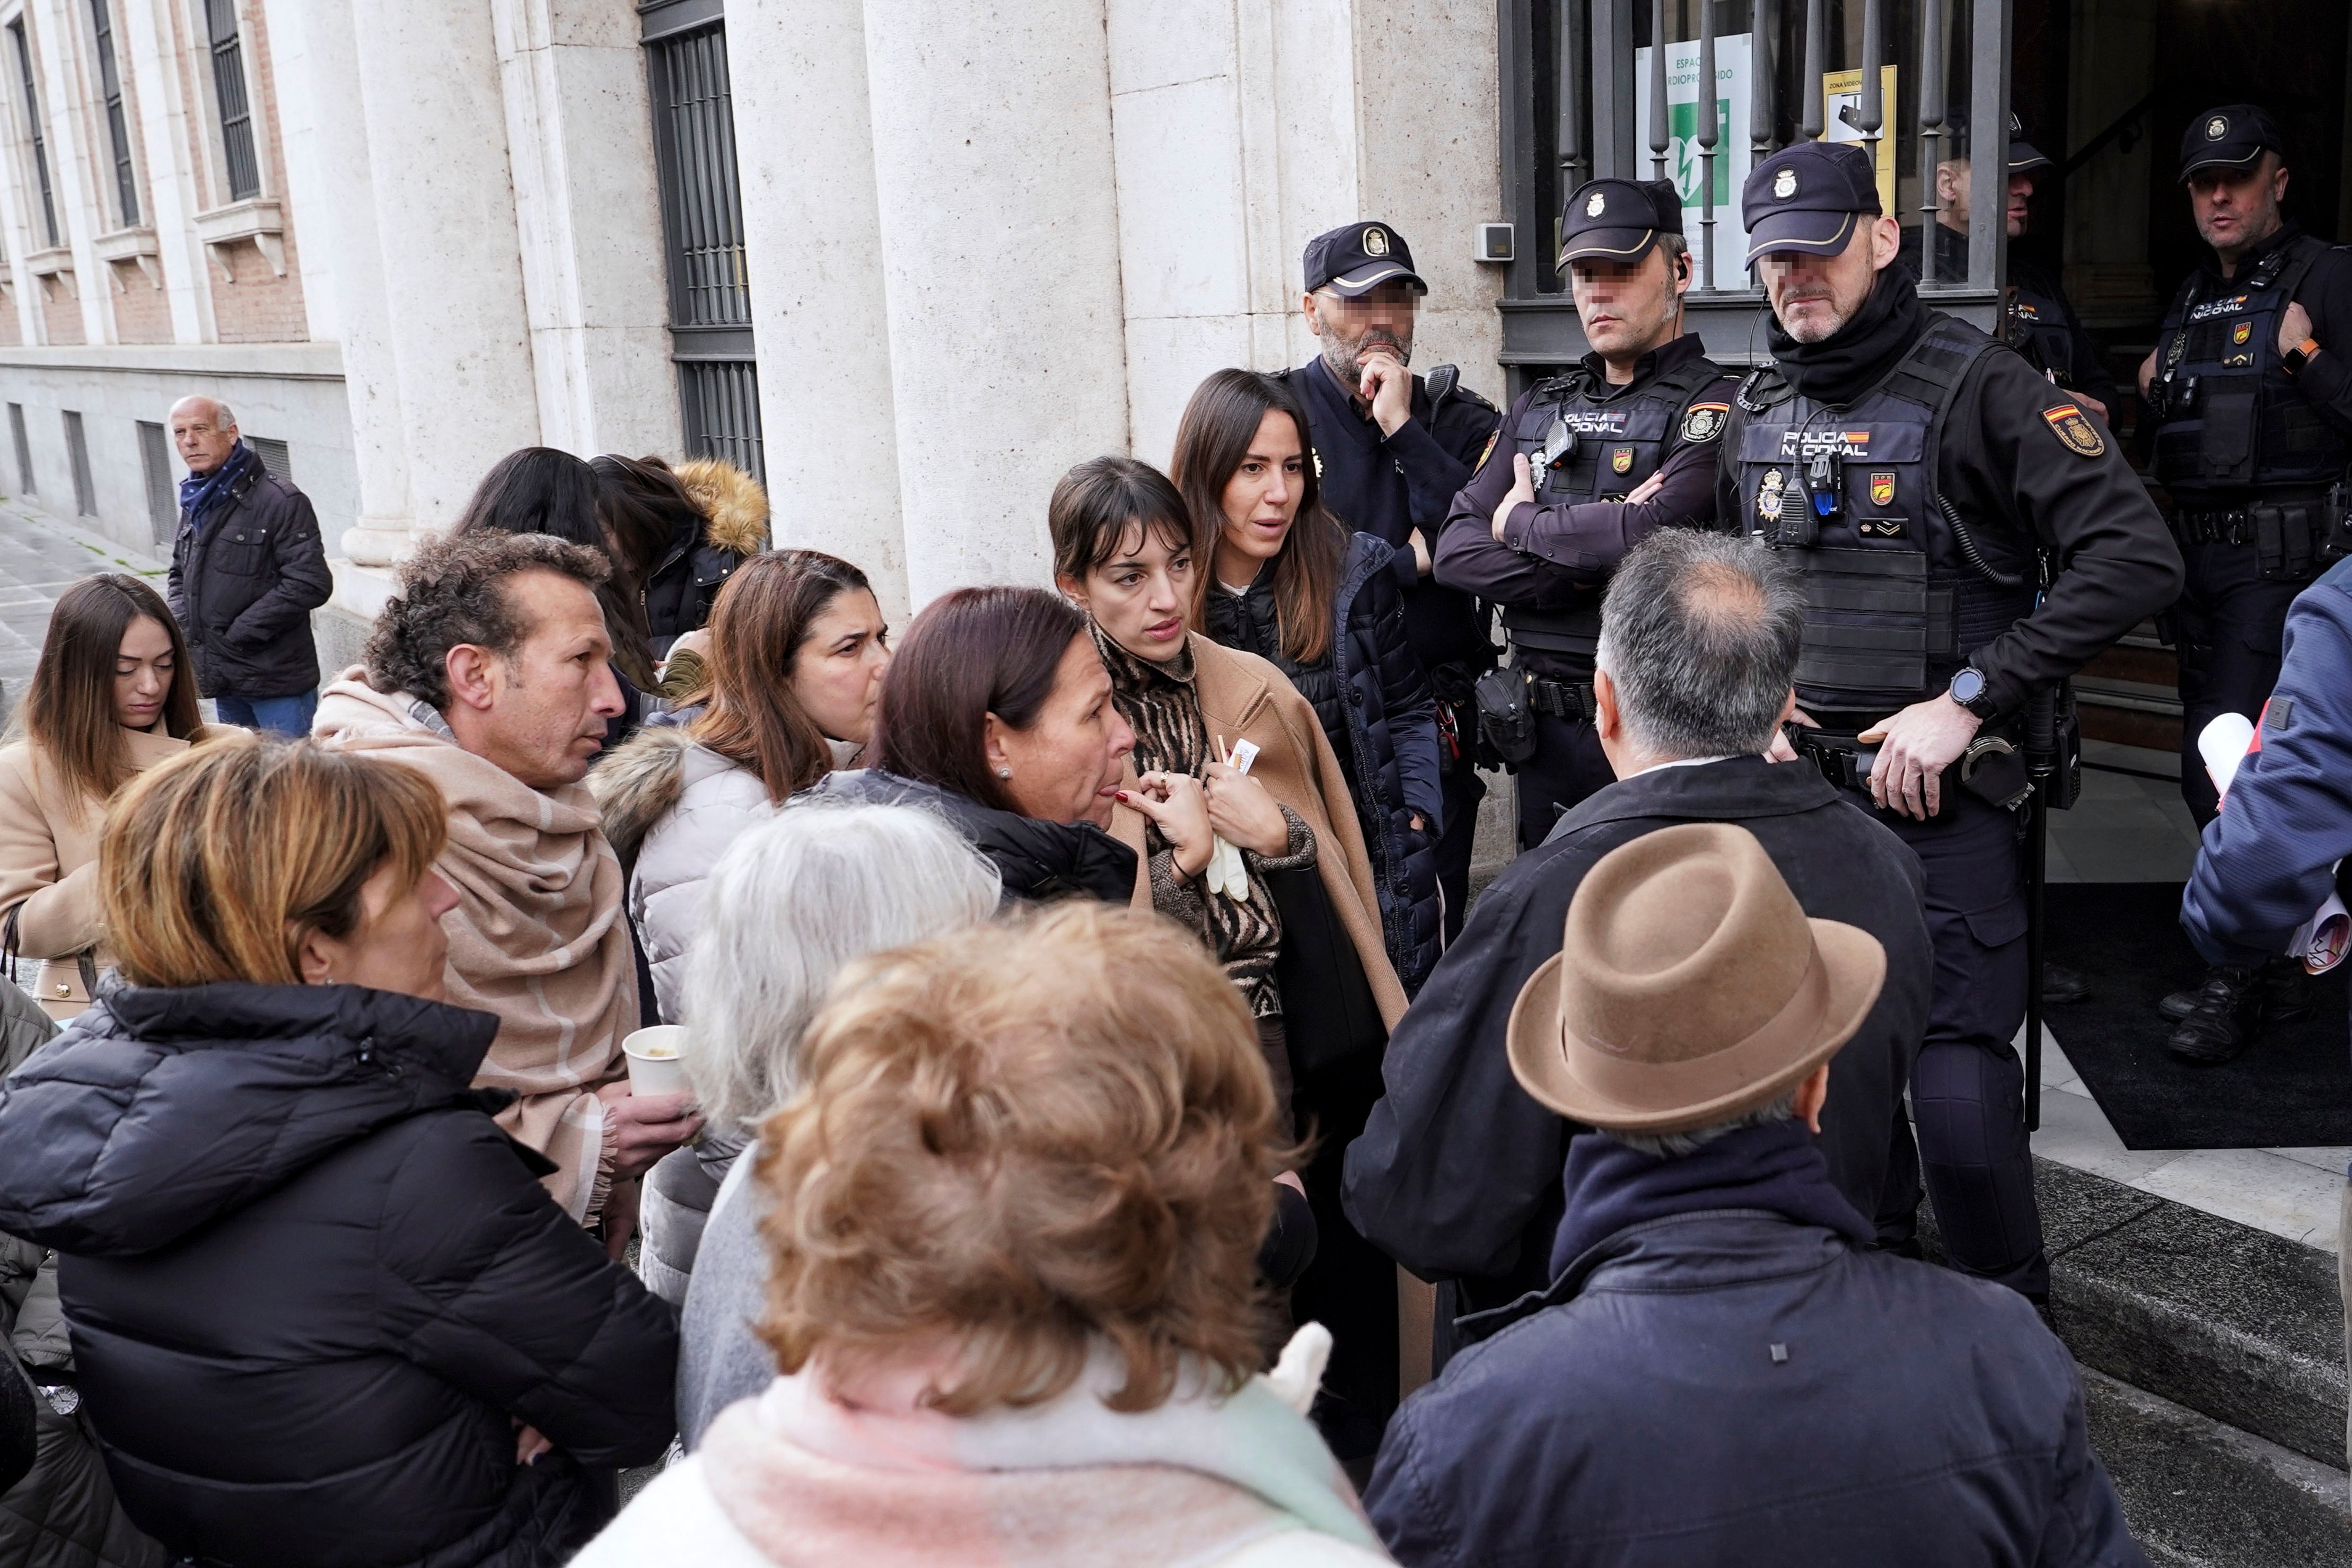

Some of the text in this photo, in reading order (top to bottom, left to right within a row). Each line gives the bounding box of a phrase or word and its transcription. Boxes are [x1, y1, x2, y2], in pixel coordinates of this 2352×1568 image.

[1676, 57, 1701, 69] ESPAC
[2190, 303, 2243, 319] NACIONAL
[1564, 412, 1608, 423] OLICIA
[1783, 431, 1849, 443] POLICIA
[2055, 424, 2076, 447] CUERPO
[1781, 444, 1868, 456] NCIONAL
